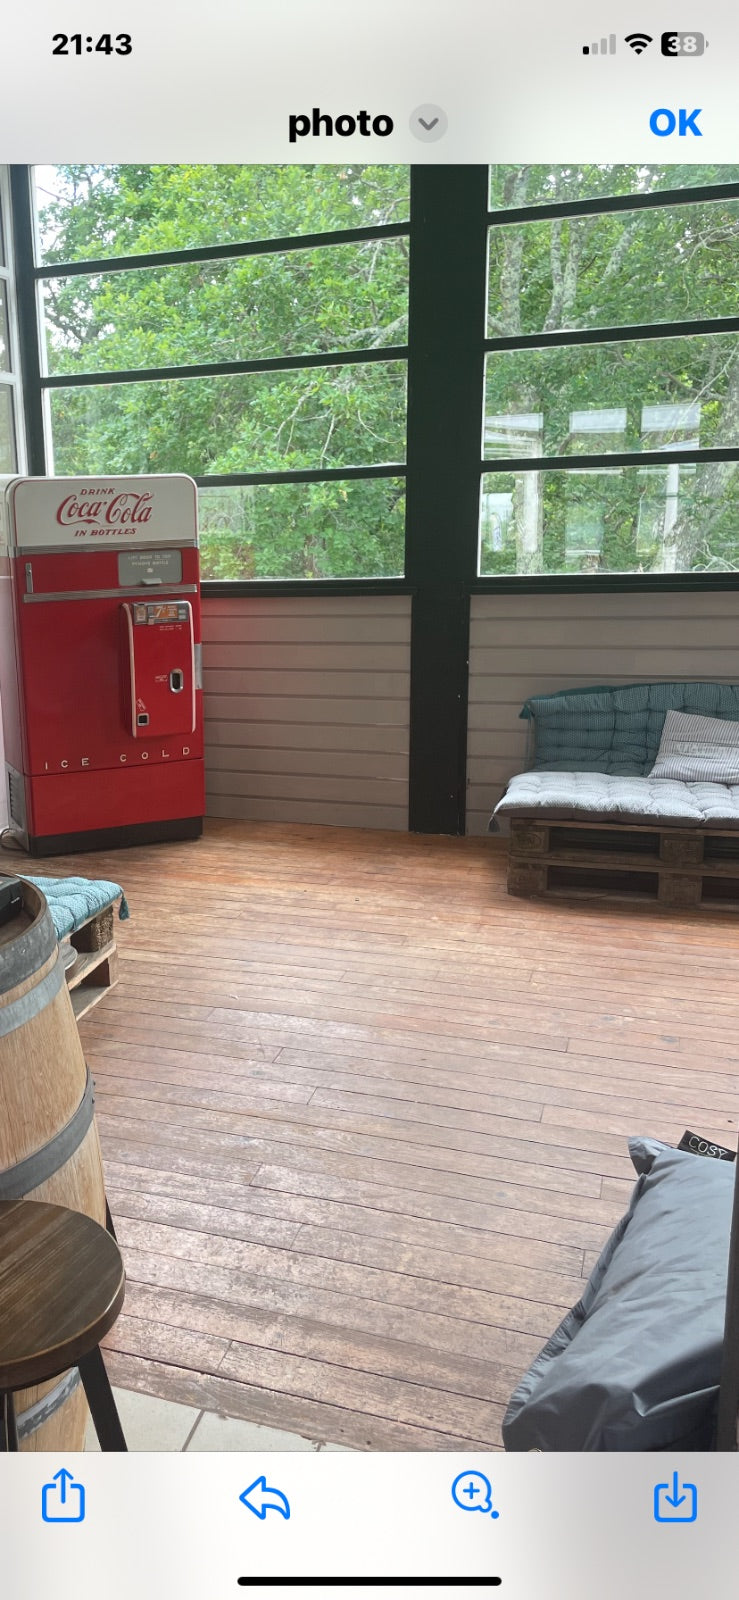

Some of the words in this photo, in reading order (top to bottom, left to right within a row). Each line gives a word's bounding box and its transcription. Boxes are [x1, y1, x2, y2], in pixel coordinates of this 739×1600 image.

[80, 487, 115, 496] DRINK
[90, 528, 137, 537] BOTTLES
[44, 757, 90, 770] ICE
[119, 747, 190, 763] COLD
[688, 1136, 728, 1159] COSY
